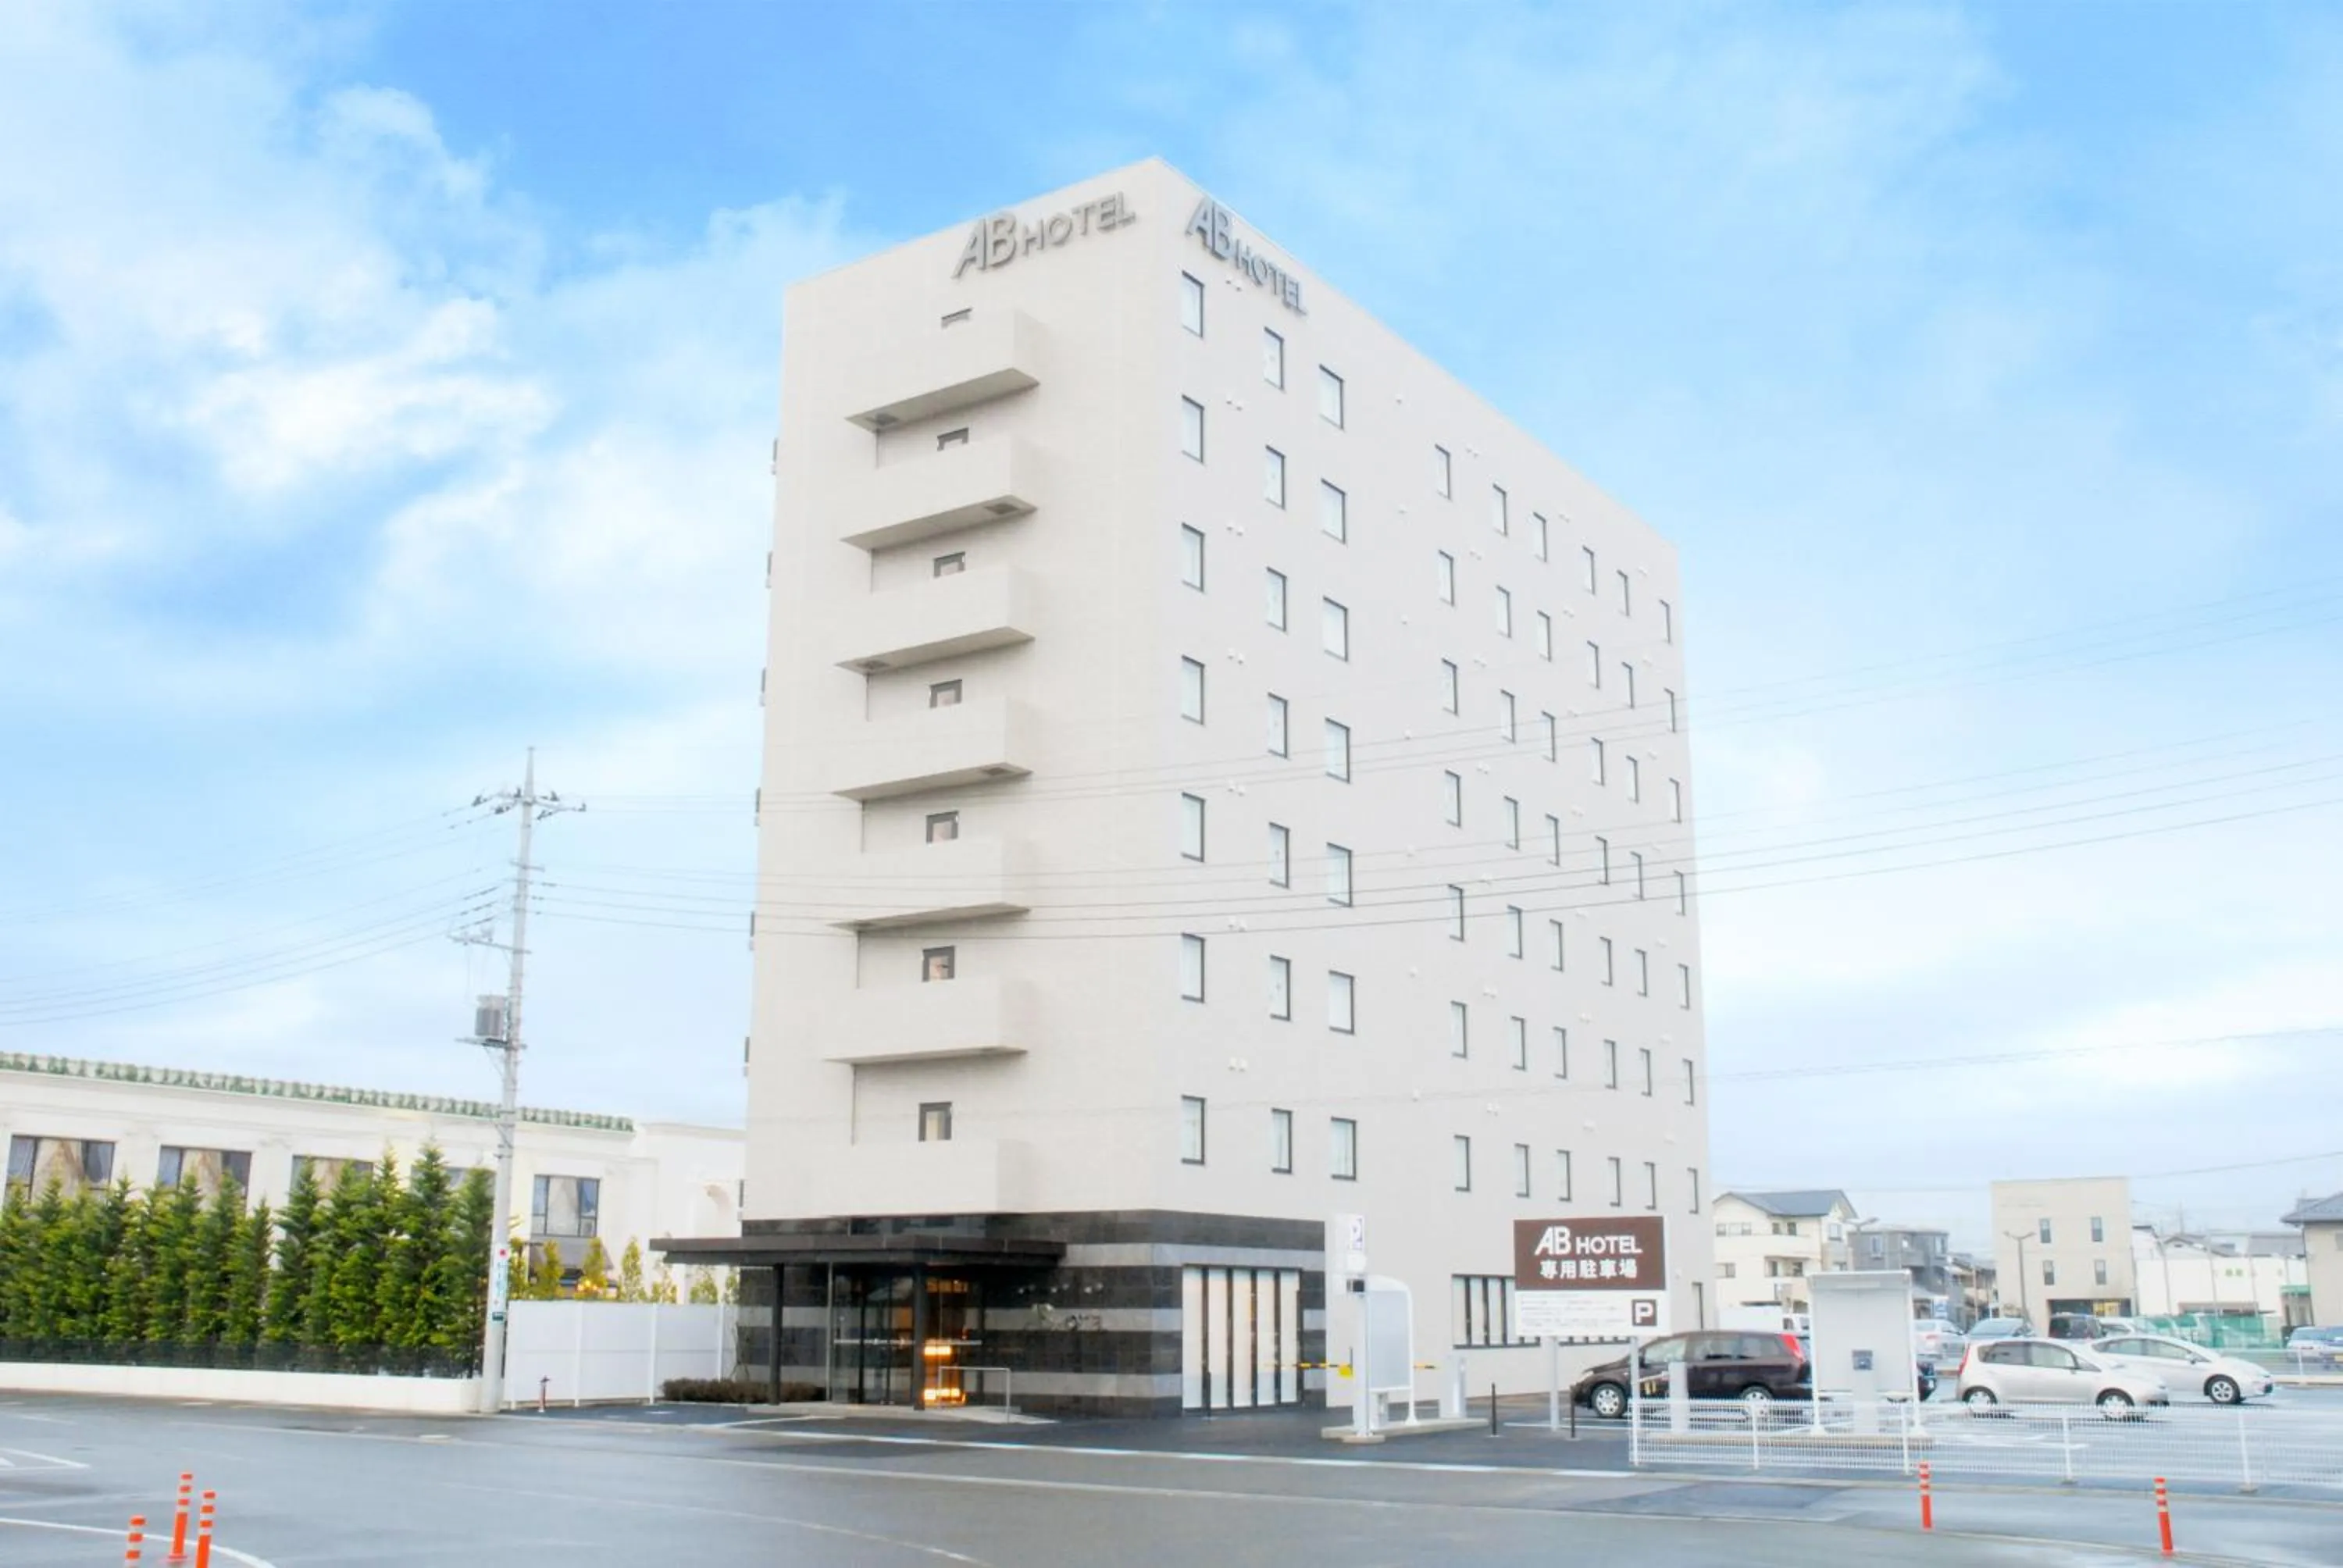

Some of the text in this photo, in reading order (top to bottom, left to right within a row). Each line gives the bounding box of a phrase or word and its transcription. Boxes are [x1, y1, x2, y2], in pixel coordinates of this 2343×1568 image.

[950, 191, 1137, 280] AB HOTEL
[1185, 196, 1308, 316] AB HOTEL
[1535, 1226, 1643, 1256] AB HOTEL
[1540, 1259, 1637, 1279] 専用駐車場
[1635, 1302, 1654, 1324] P
